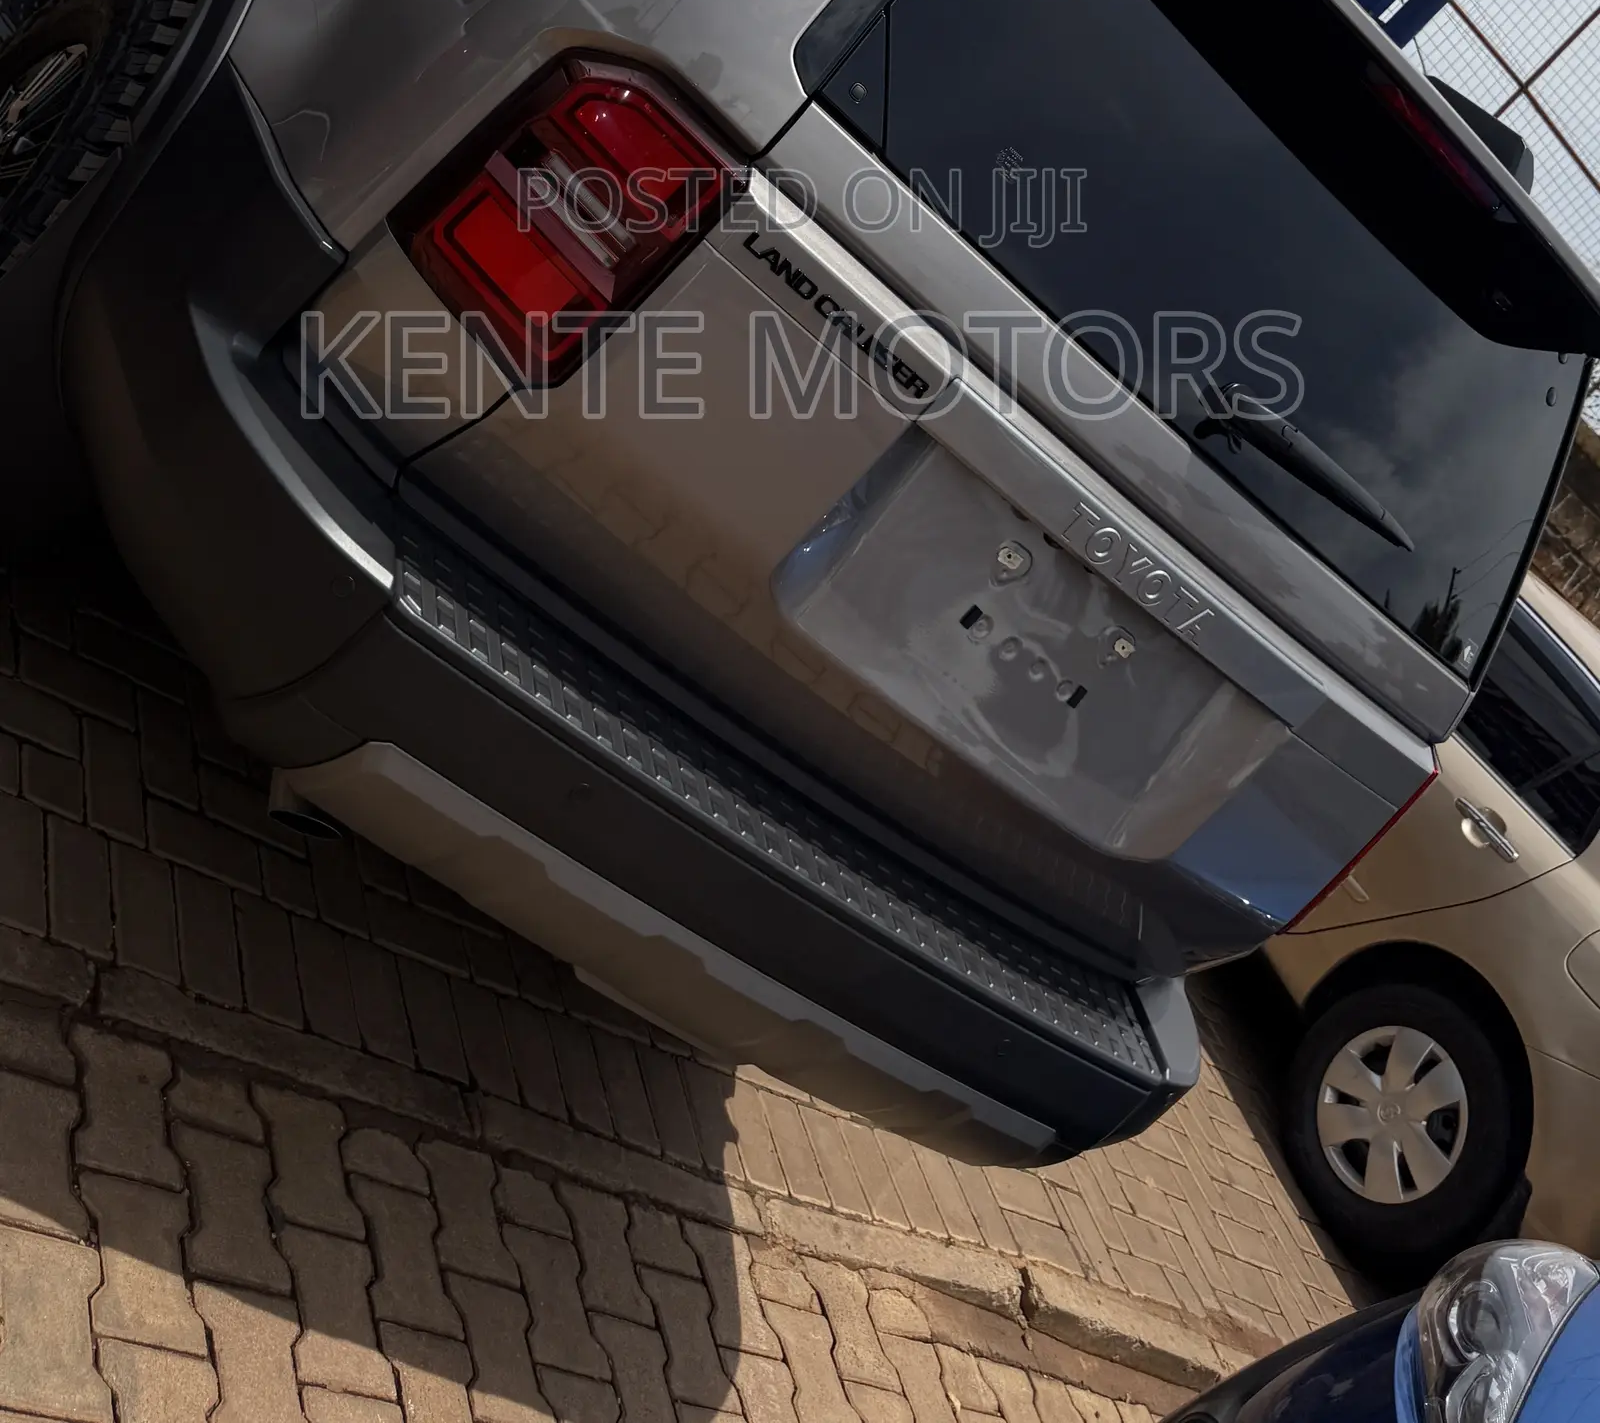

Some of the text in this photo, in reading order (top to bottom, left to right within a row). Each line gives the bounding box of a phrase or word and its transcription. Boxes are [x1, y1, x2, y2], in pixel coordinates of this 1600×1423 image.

[743, 231, 930, 399] LAND CRUISER
[1060, 501, 1215, 648] TOYOTA
